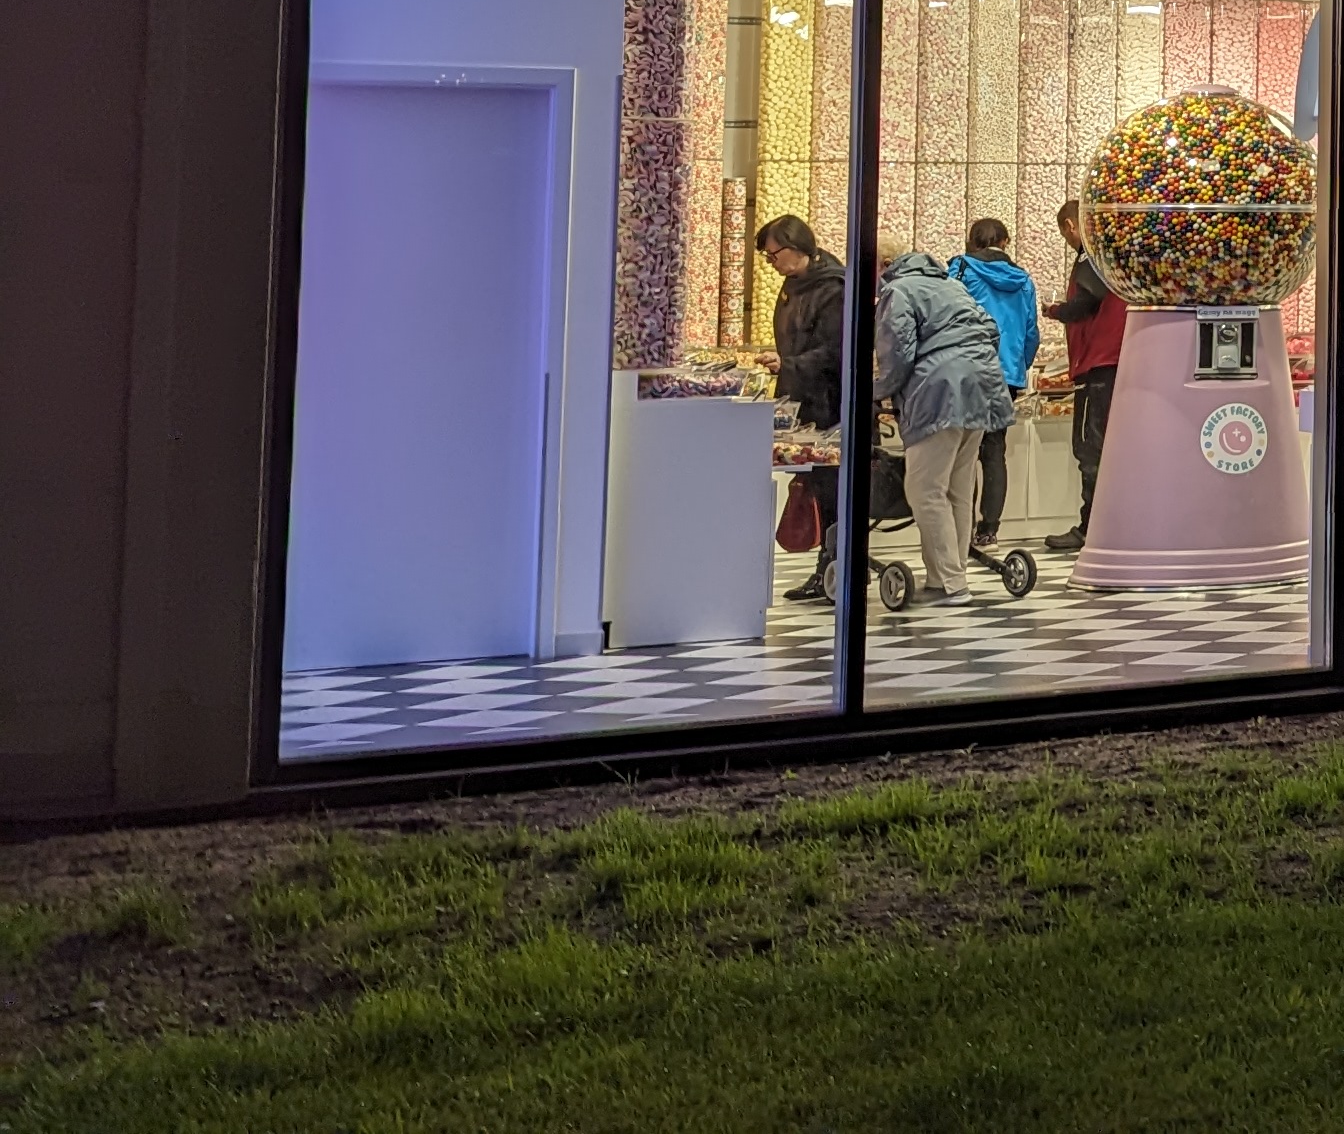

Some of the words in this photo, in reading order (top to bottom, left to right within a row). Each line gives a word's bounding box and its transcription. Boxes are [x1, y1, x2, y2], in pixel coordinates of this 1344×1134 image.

[1203, 408, 1228, 438] SWEET
[1230, 405, 1266, 436] FACTORY
[1216, 458, 1255, 472] STORE
